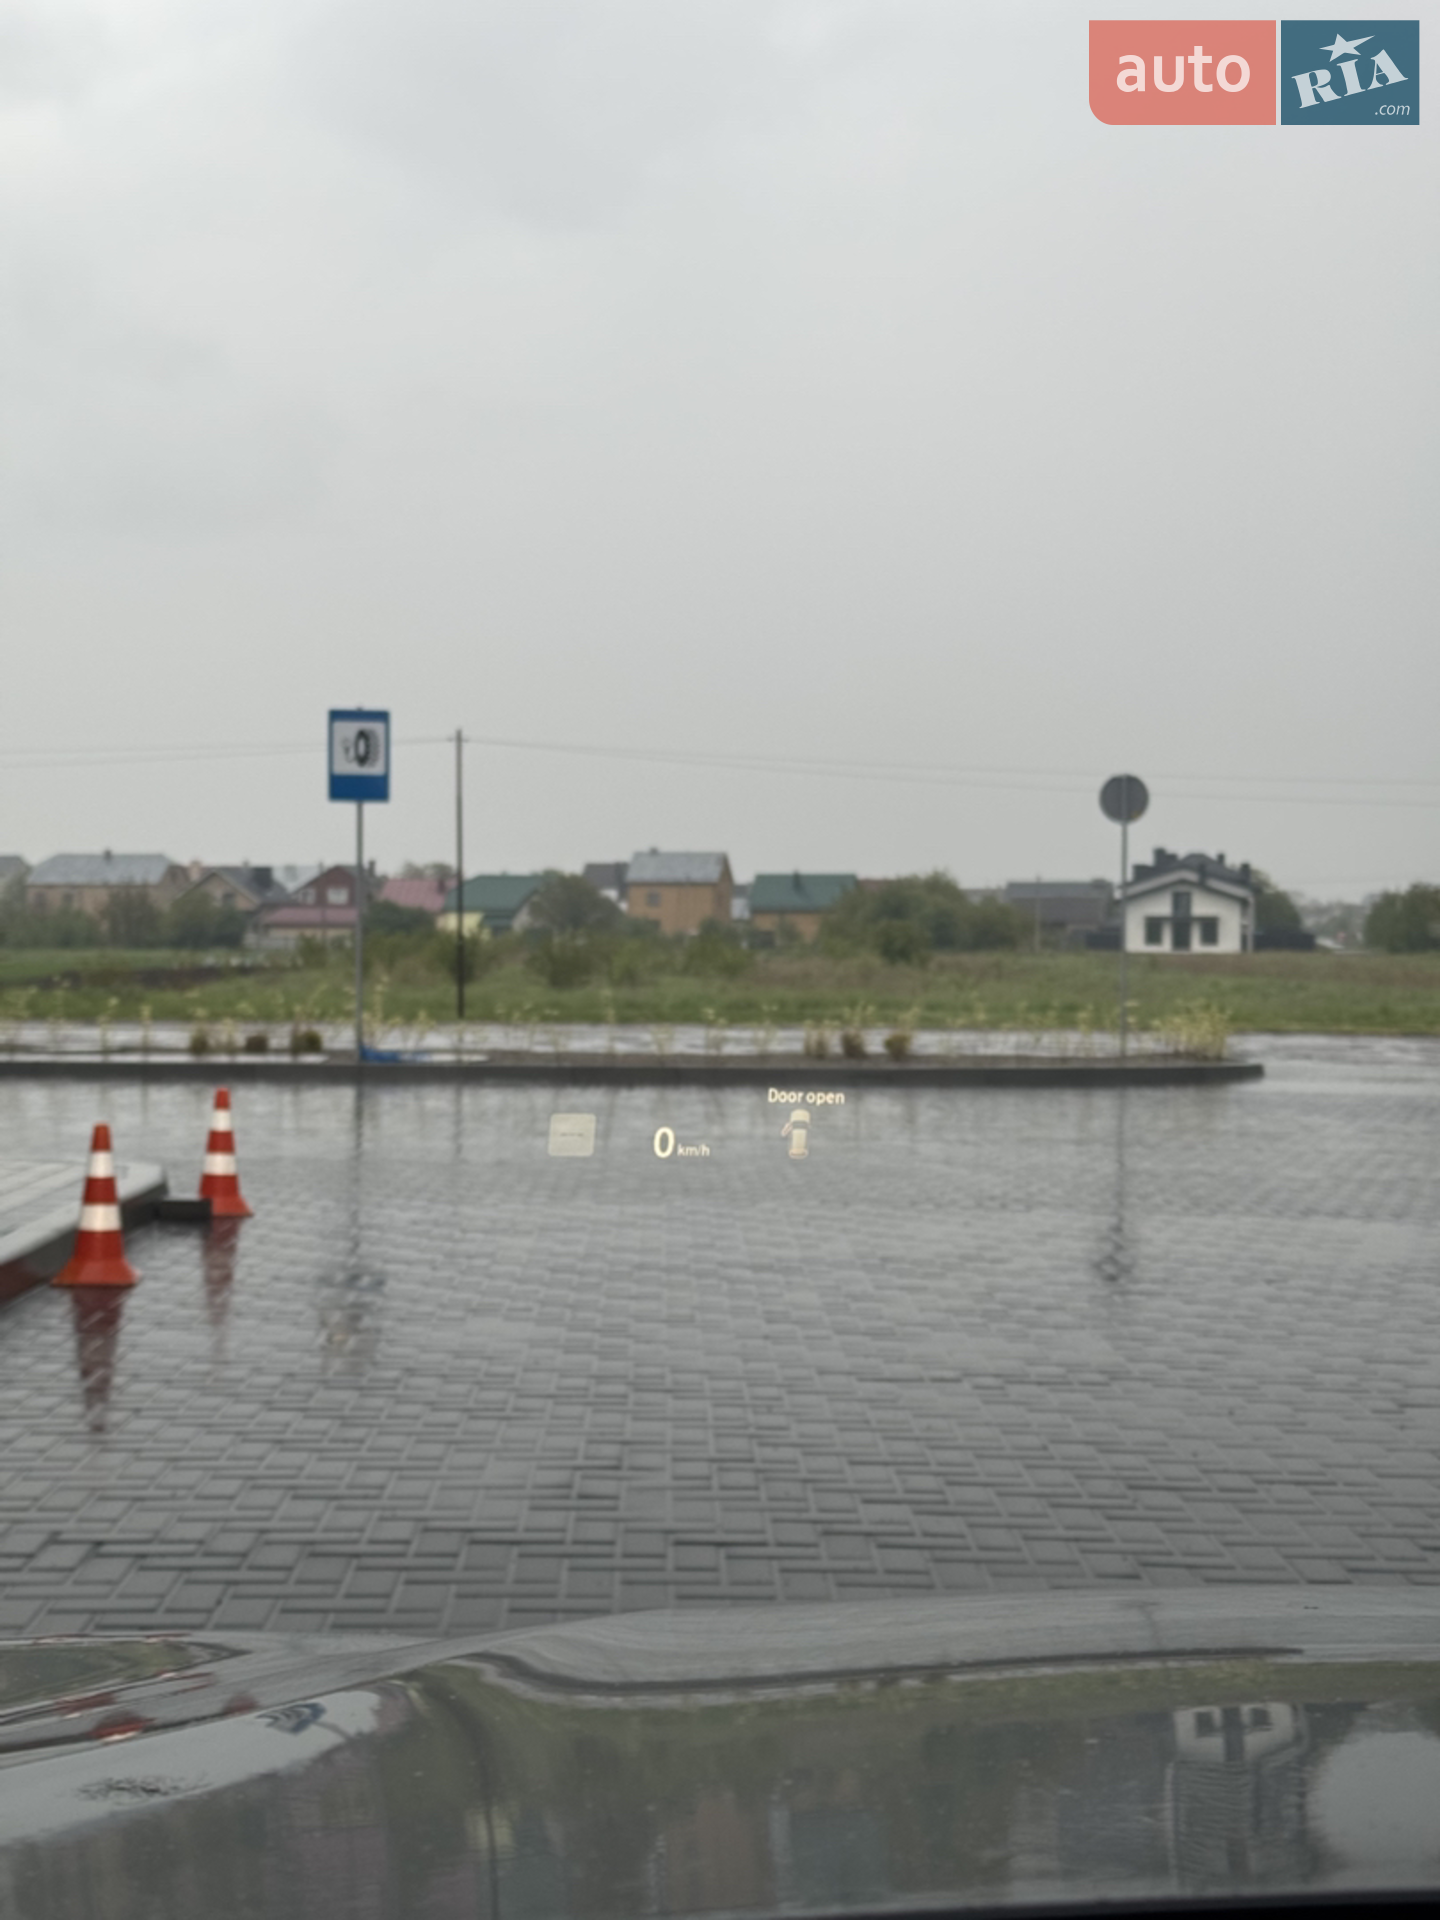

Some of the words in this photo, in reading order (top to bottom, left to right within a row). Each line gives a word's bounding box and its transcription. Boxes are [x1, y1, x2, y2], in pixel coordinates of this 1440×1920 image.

[768, 1088, 803, 1104] Door
[806, 1091, 845, 1106] open
[653, 1126, 675, 1158] 0
[677, 1143, 710, 1157] km/h
